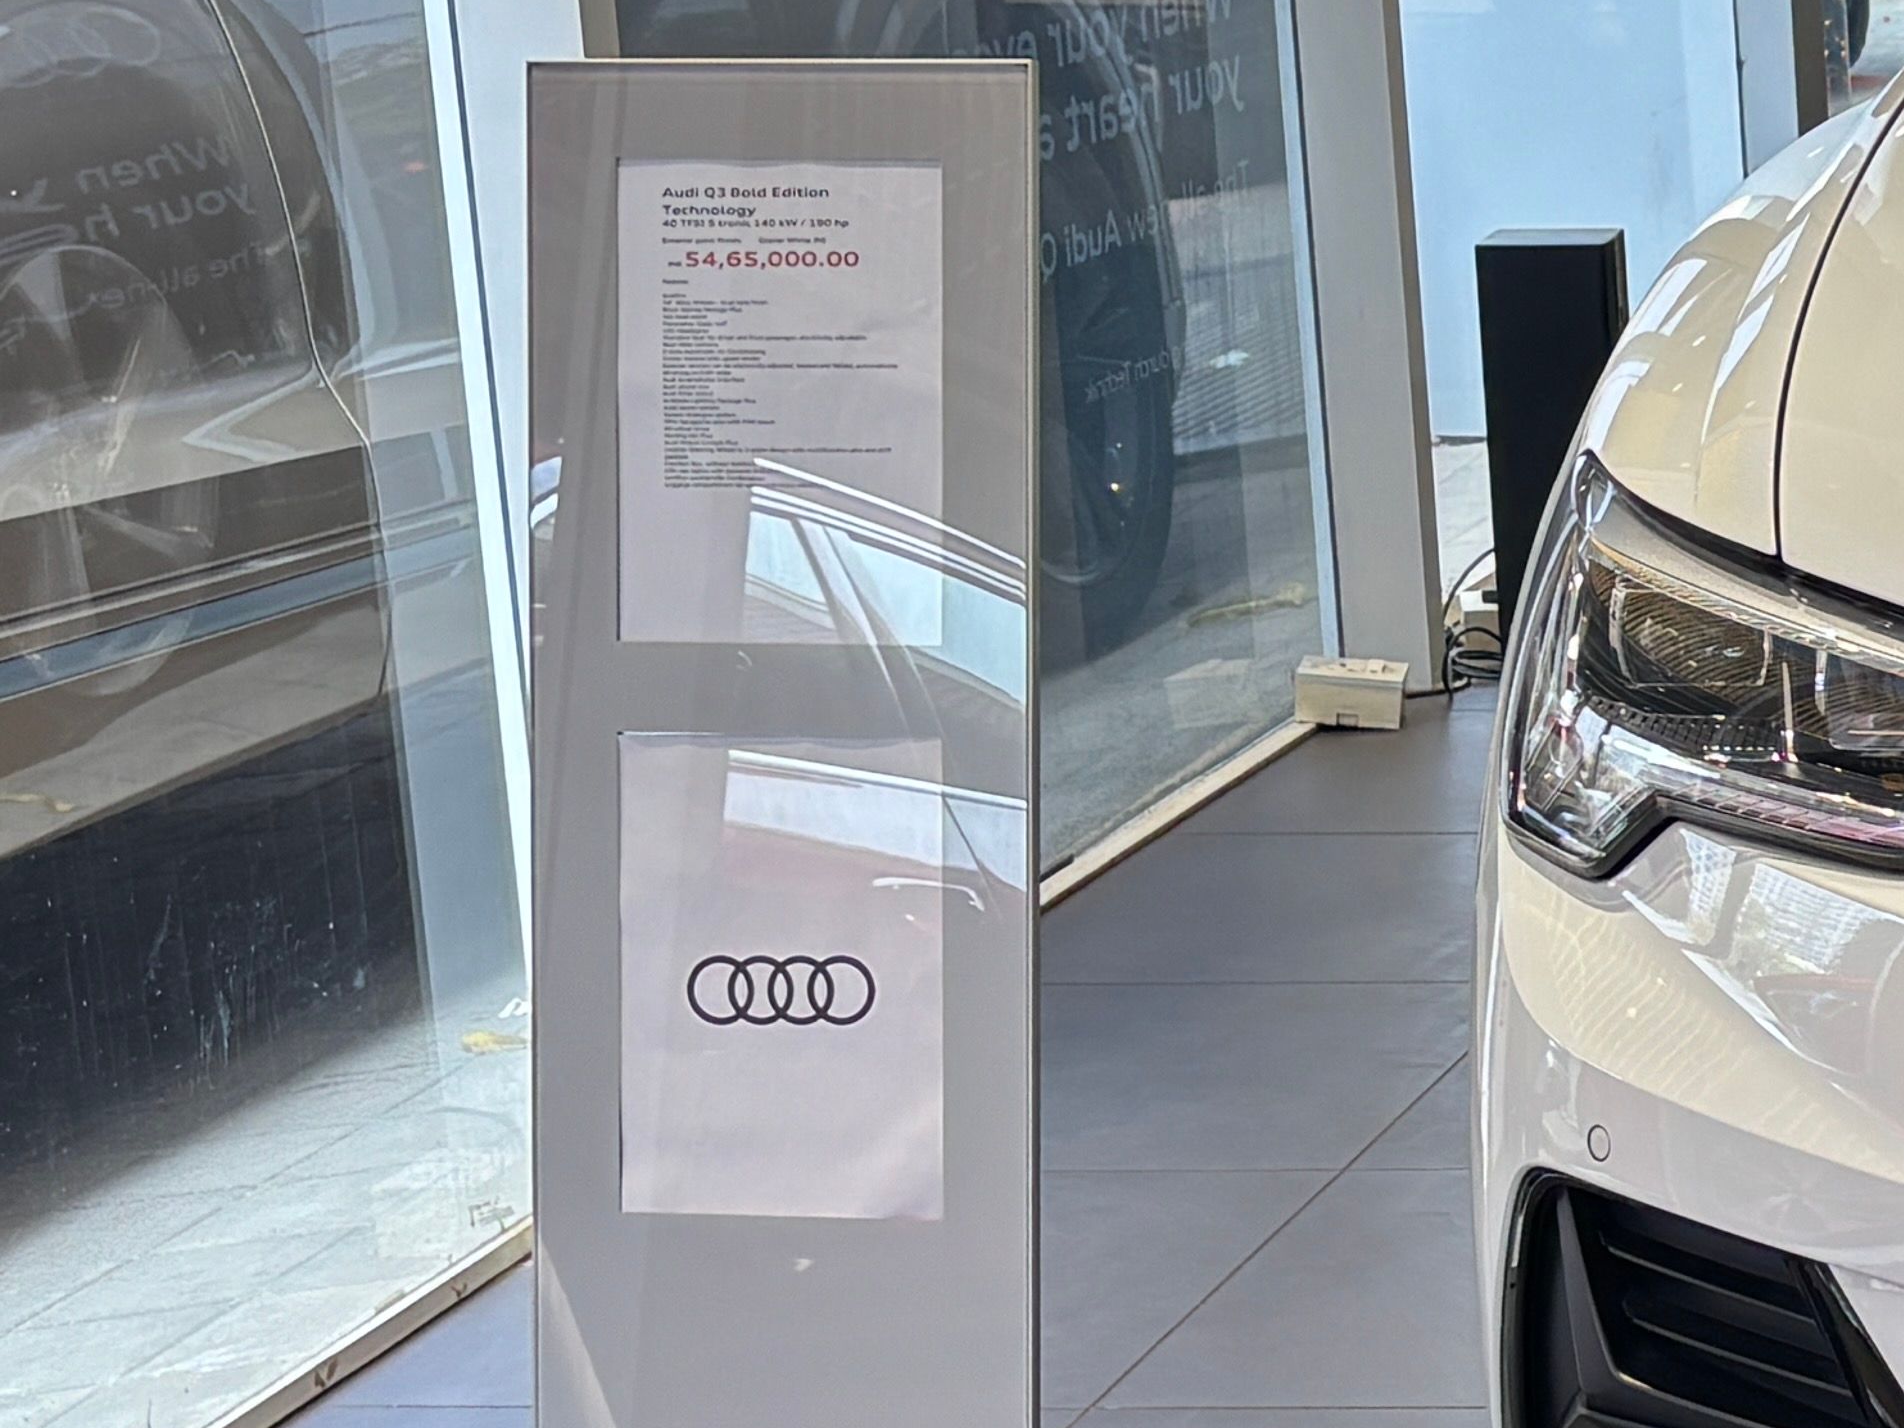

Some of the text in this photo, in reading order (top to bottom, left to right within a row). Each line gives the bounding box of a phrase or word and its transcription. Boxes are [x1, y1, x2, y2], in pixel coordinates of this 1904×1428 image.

[661, 186, 830, 200] Audi Q3 Bold Edition
[661, 204, 756, 218] Technology
[834, 219, 850, 229] hp
[685, 251, 860, 270] 54,65,000.00
